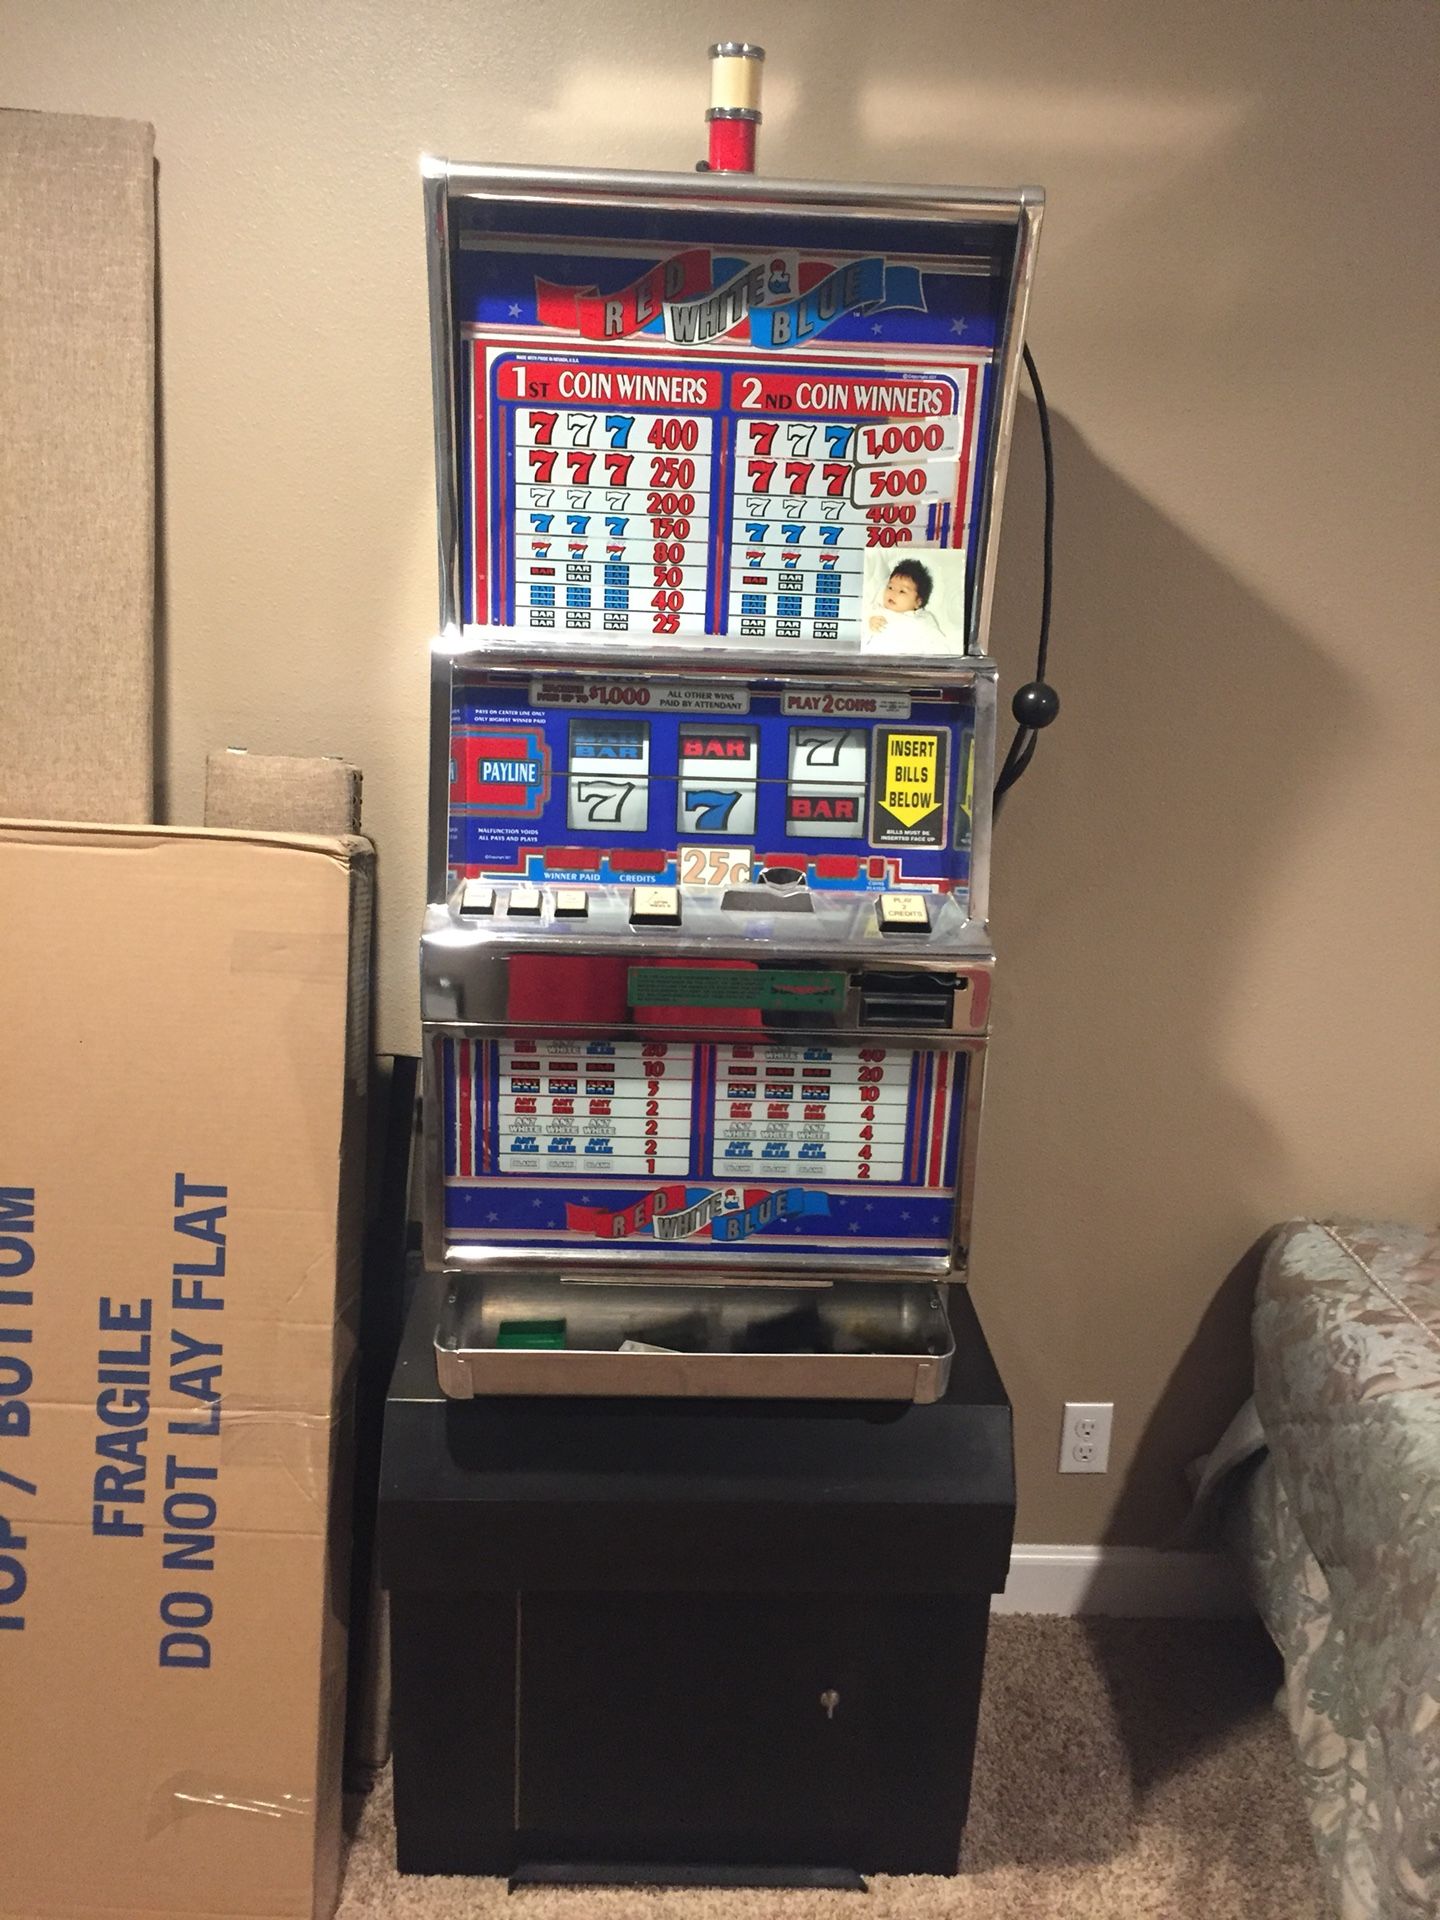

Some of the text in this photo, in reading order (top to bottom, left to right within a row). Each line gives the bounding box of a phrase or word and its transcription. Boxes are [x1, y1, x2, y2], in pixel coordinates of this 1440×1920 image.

[605, 261, 685, 336] RED
[671, 264, 765, 342] WHITE
[772, 263, 862, 346] BLUE
[512, 366, 708, 404] 1ST COIN WINNERS
[741, 377, 943, 414] 2ND COIN WINNERS
[529, 411, 699, 451] 7 7 7 400
[750, 422, 944, 459] 7 7 7 1,000
[529, 450, 695, 489] 7 7 7 250
[748, 460, 927, 497] 7 7 7 500
[530, 488, 695, 515] 7 7 7 200
[746, 498, 916, 524] 7 7 7 400
[530, 513, 690, 540] 7 7 7 150
[745, 523, 913, 548] 7 7 7 300
[531, 541, 685, 564] 7 7 7 80
[746, 551, 839, 570] 7 7 7
[531, 567, 554, 576] BAR
[567, 564, 591, 572] BAR
[653, 566, 683, 588] 50
[780, 573, 802, 581] BAR
[567, 574, 591, 582] BAR
[743, 576, 766, 585] BAR
[651, 590, 684, 611] 40
[652, 614, 681, 634] 25
[589, 684, 651, 706] $1,000
[659, 699, 743, 710] PAID BY ATTENDANT
[684, 691, 712, 700] OTHER
[714, 692, 735, 701] WINS
[788, 696, 821, 710] PLAY
[822, 694, 834, 713] 2
[834, 698, 877, 712] COINS
[575, 746, 638, 758] BAR
[683, 737, 746, 757] BAR
[795, 729, 850, 767] 7
[891, 740, 934, 757] INSERT
[483, 761, 536, 783] PAYLINE
[895, 766, 928, 783] BILLS
[578, 780, 636, 823] 7
[791, 799, 854, 819] BAR
[889, 791, 932, 809] BELOW
[685, 790, 742, 831] 7
[544, 872, 600, 881] WINNER PAID
[619, 874, 656, 883] CREDITS
[643, 1061, 665, 1077] 10
[857, 1066, 884, 1082] 20
[647, 1081, 659, 1096] 5
[859, 1086, 880, 1101] 10
[646, 1100, 659, 1116] 2
[861, 1106, 875, 1121] 4
[509, 1125, 616, 1135] WHITE WHITE WHITE
[515, 1117, 659, 1135] ANY ANY ANY 2
[859, 1125, 874, 1141] 4
[645, 1140, 657, 1154] 2
[858, 1144, 872, 1160] 4
[645, 1159, 656, 1173] 1
[857, 1163, 870, 1179] 2
[613, 1192, 667, 1236] RED
[658, 1193, 722, 1238] WHITE
[727, 1192, 787, 1239] BLUE
[93, 1296, 153, 1537] FRAGILE
[159, 1172, 229, 1669] DO NOT LAY FLAT
